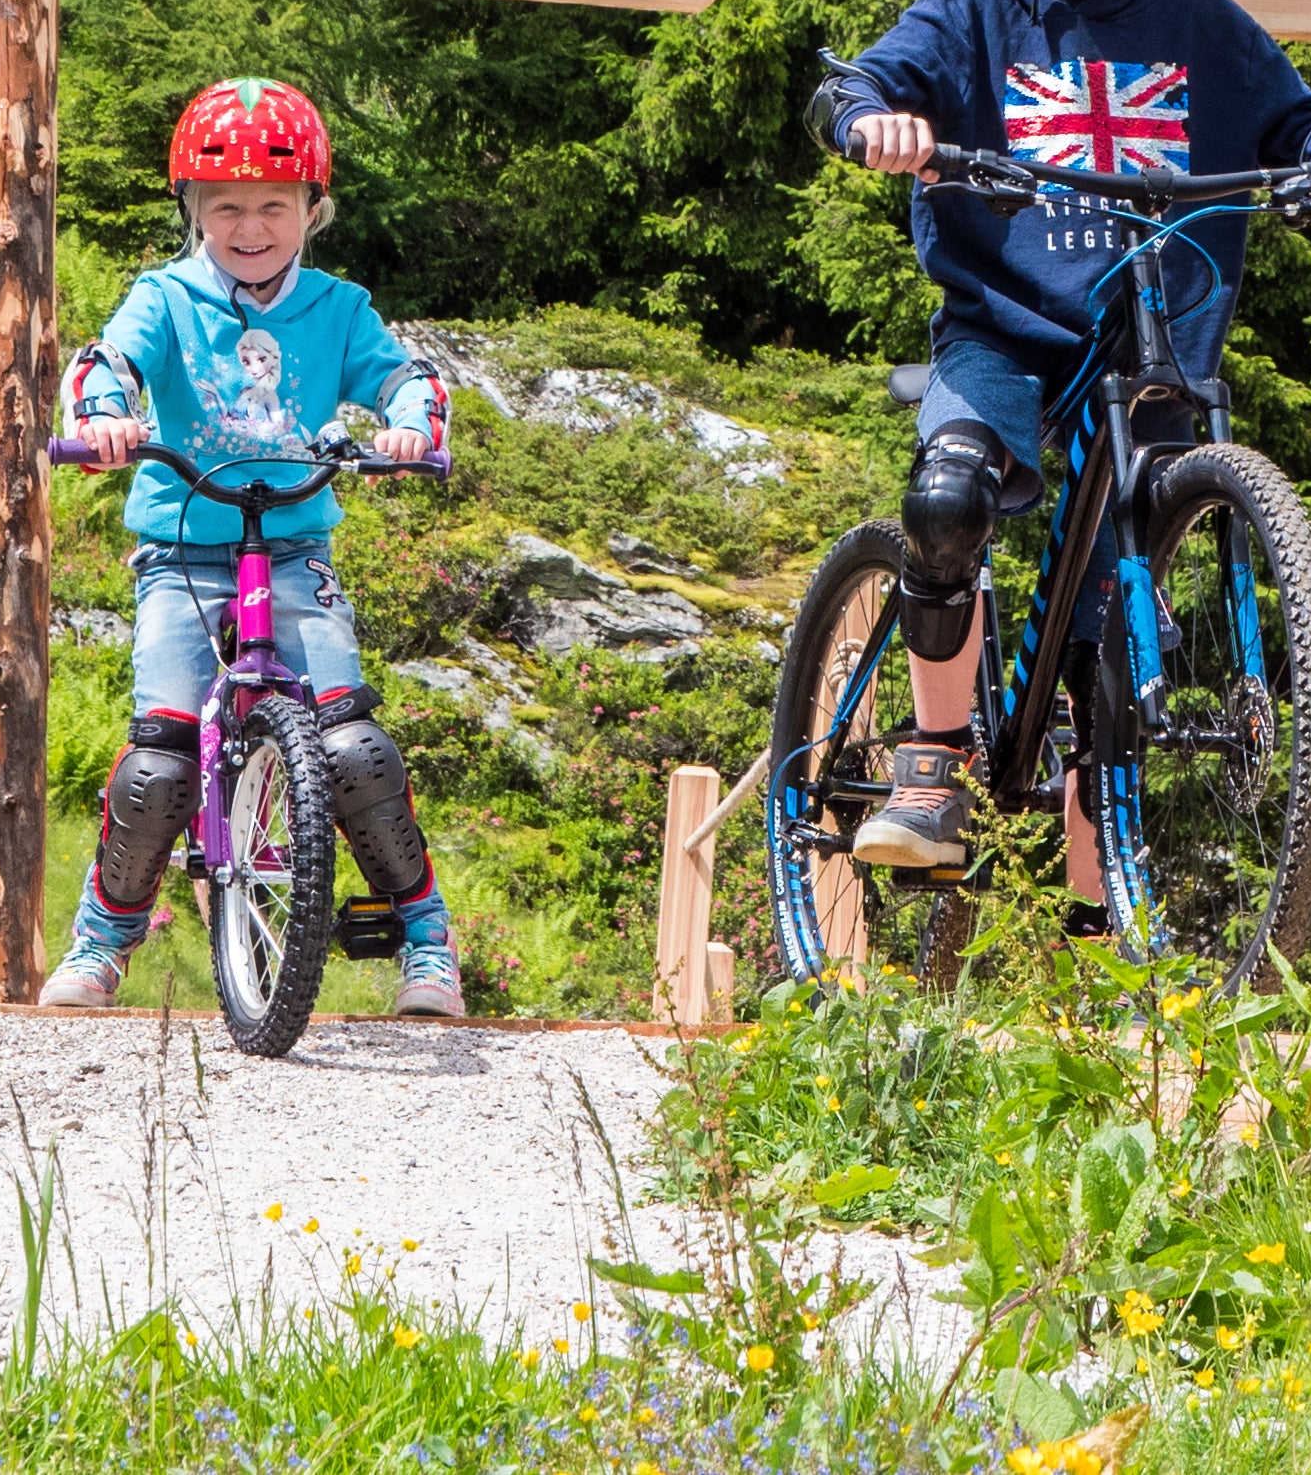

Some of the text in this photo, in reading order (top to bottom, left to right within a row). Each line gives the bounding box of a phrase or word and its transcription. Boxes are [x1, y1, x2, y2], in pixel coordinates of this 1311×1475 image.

[229, 161, 264, 179] TSG
[1103, 821, 1116, 867] Country
[777, 900, 798, 962] MICHELIN
